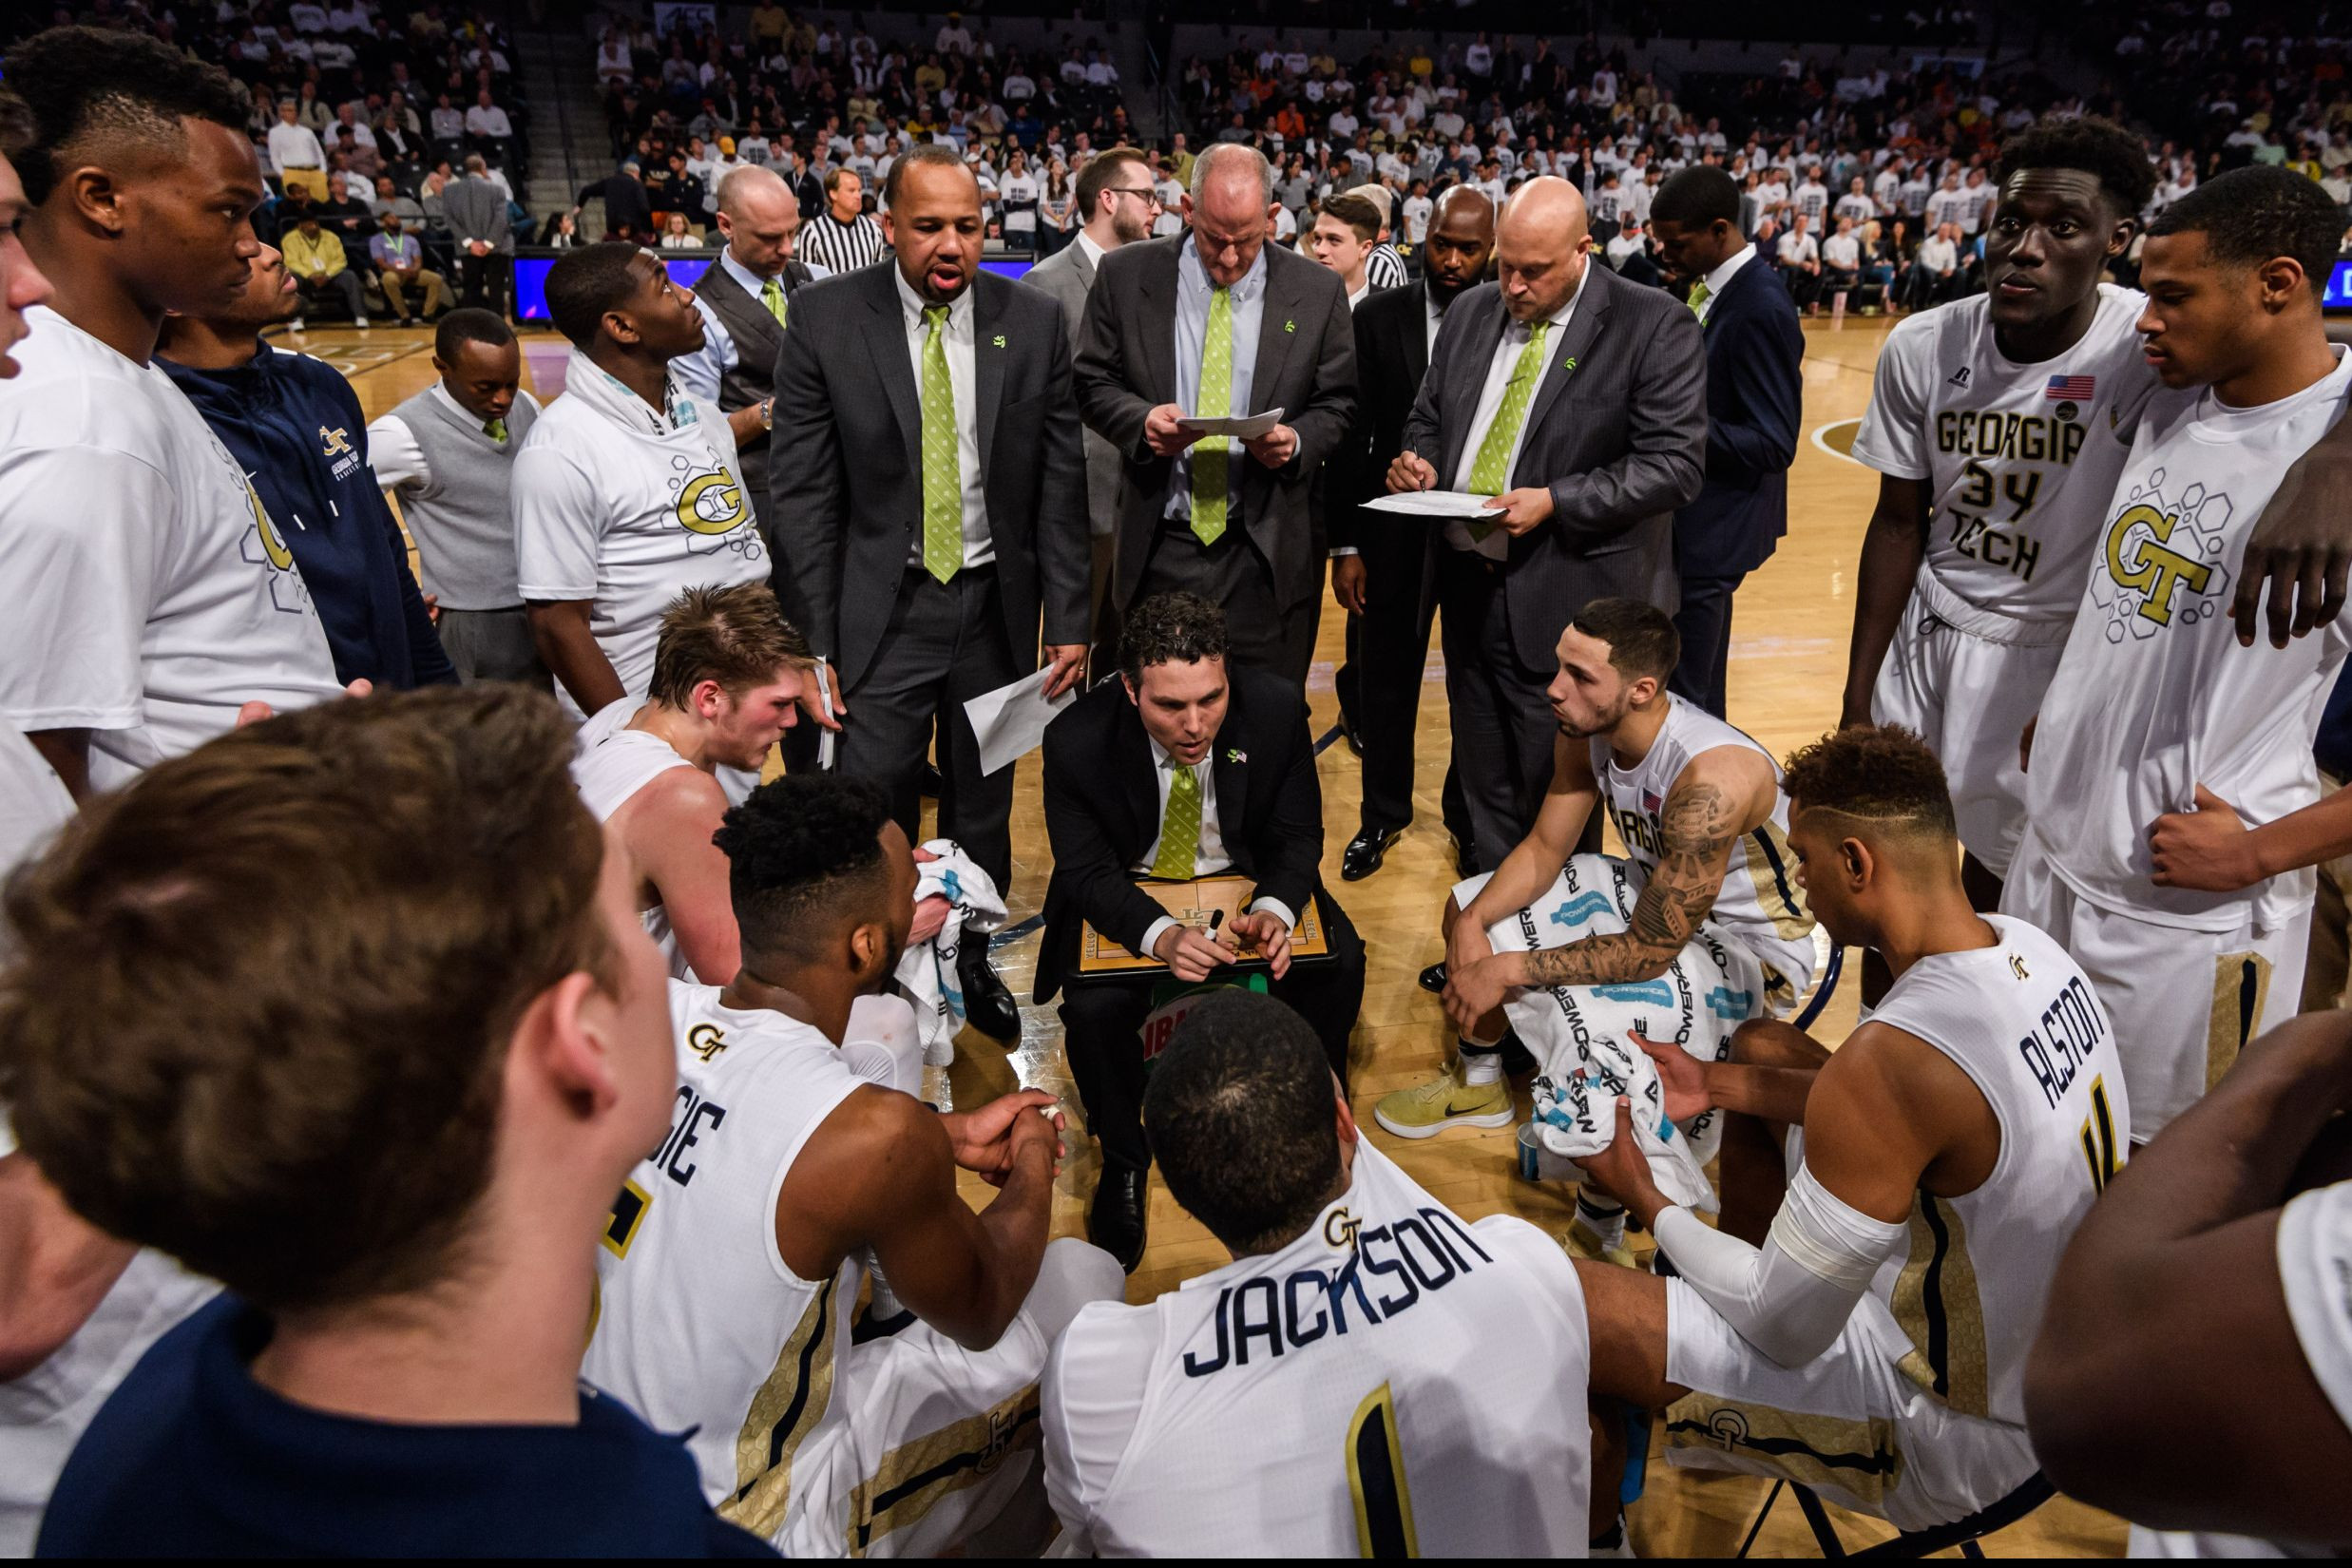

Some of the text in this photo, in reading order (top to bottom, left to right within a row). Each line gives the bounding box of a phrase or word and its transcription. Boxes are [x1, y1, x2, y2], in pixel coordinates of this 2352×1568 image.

[1938, 411, 2086, 465] GEORGIA
[1960, 462, 2042, 522] 34
[1946, 507, 2041, 583] TECH
[2106, 504, 2212, 628] GT
[2008, 951, 2030, 982] GT
[687, 1022, 728, 1064] GT
[2019, 975, 2104, 1111] ALSTON
[1323, 1206, 1365, 1254] GT
[1183, 1207, 1494, 1378] JACKSON
[1345, 1379, 1420, 1558] 1
